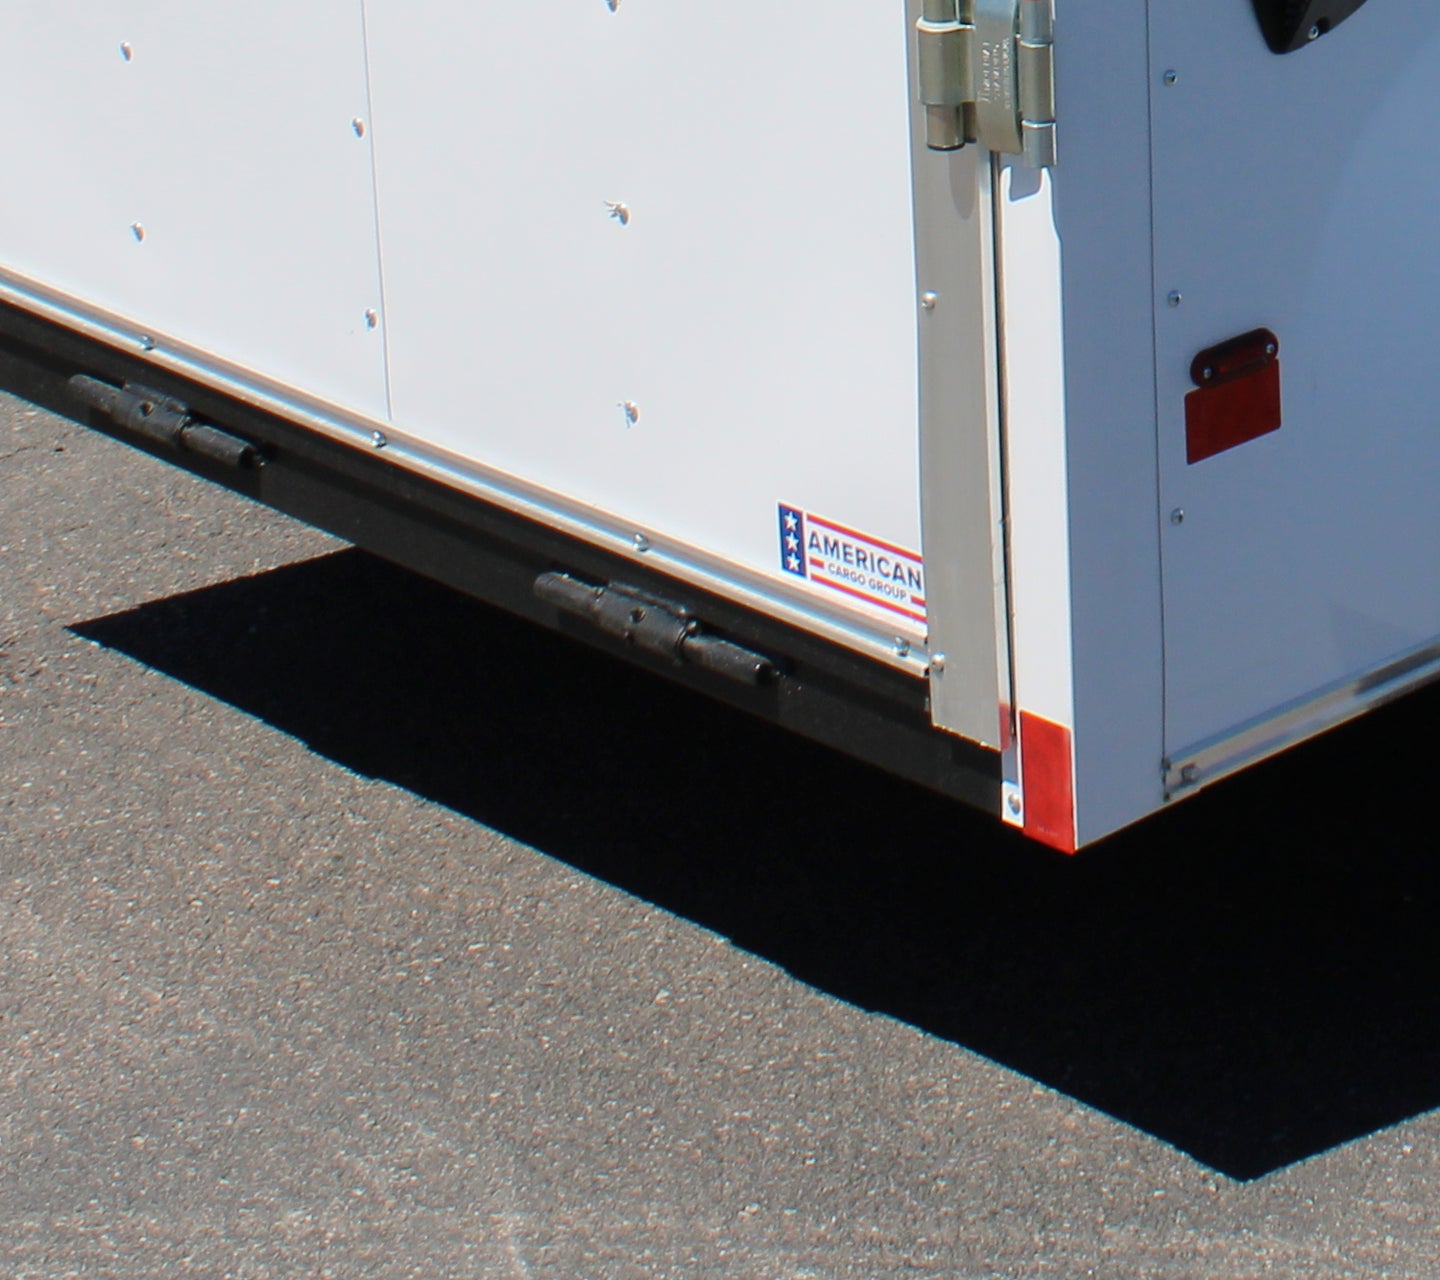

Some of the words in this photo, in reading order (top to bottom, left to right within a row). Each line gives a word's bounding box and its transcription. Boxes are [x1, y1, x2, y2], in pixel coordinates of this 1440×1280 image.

[807, 530, 922, 591] AMERICAN
[827, 563, 866, 587] CARGO
[868, 577, 907, 601] GROUP
